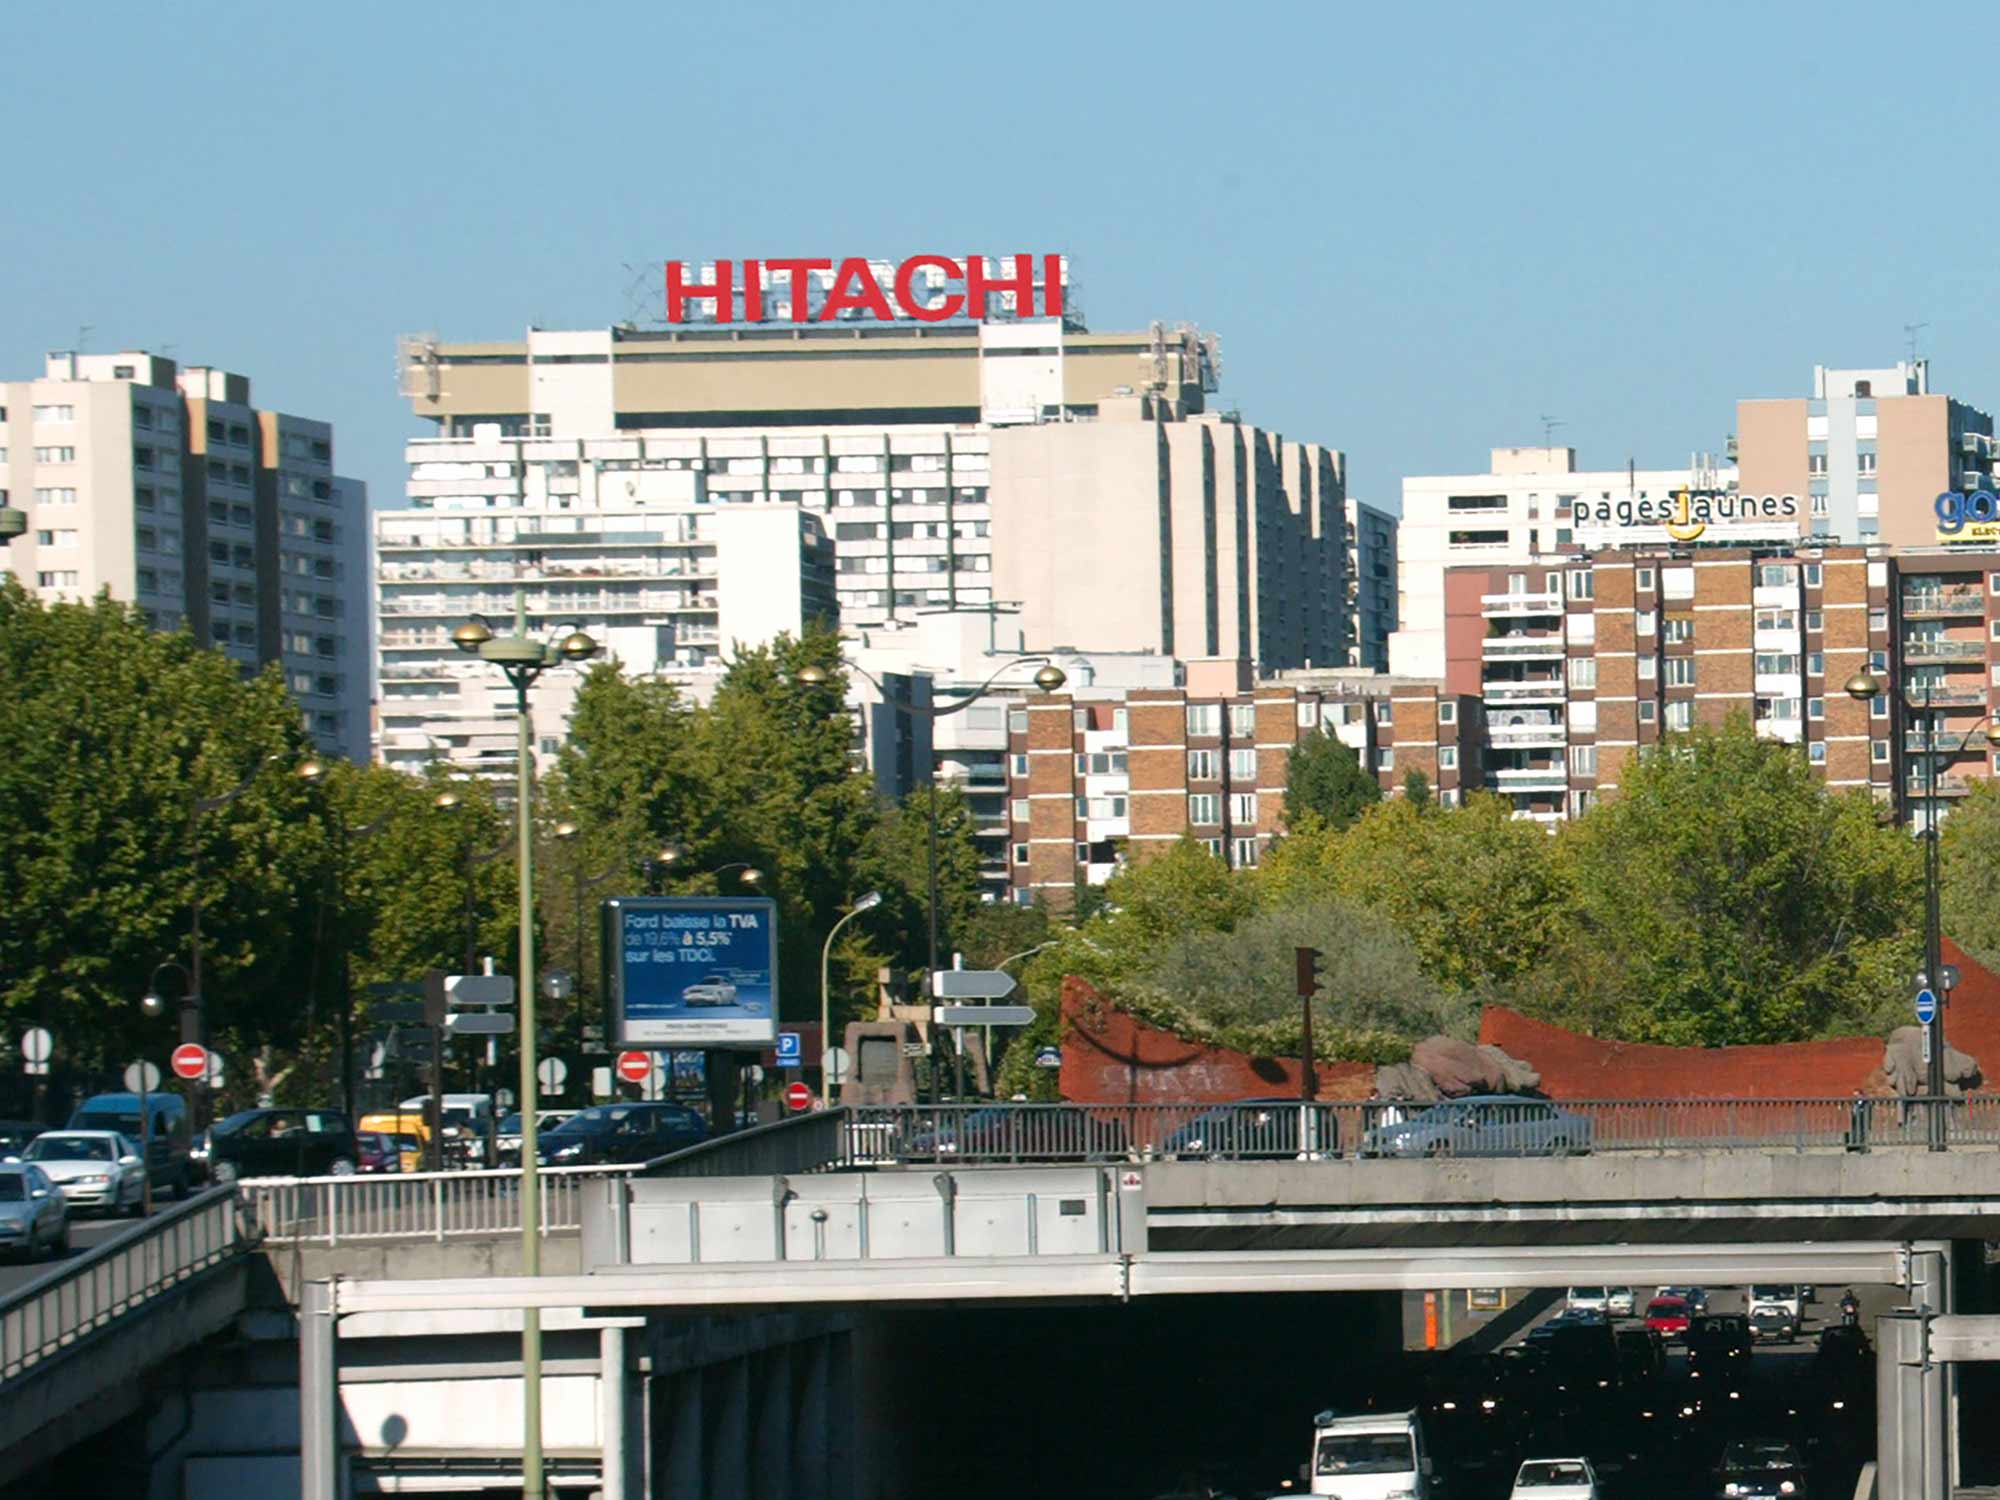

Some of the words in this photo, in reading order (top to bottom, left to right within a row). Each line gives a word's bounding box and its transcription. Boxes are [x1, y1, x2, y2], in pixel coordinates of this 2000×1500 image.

[666, 254, 1062, 323] HITACHI
[625, 914, 659, 928] Ford
[662, 914, 710, 928] baisse
[713, 914, 727, 928] la
[729, 914, 758, 928] TVA
[625, 951, 648, 963] sur
[652, 949, 675, 963] les
[781, 1038, 793, 1051] P
